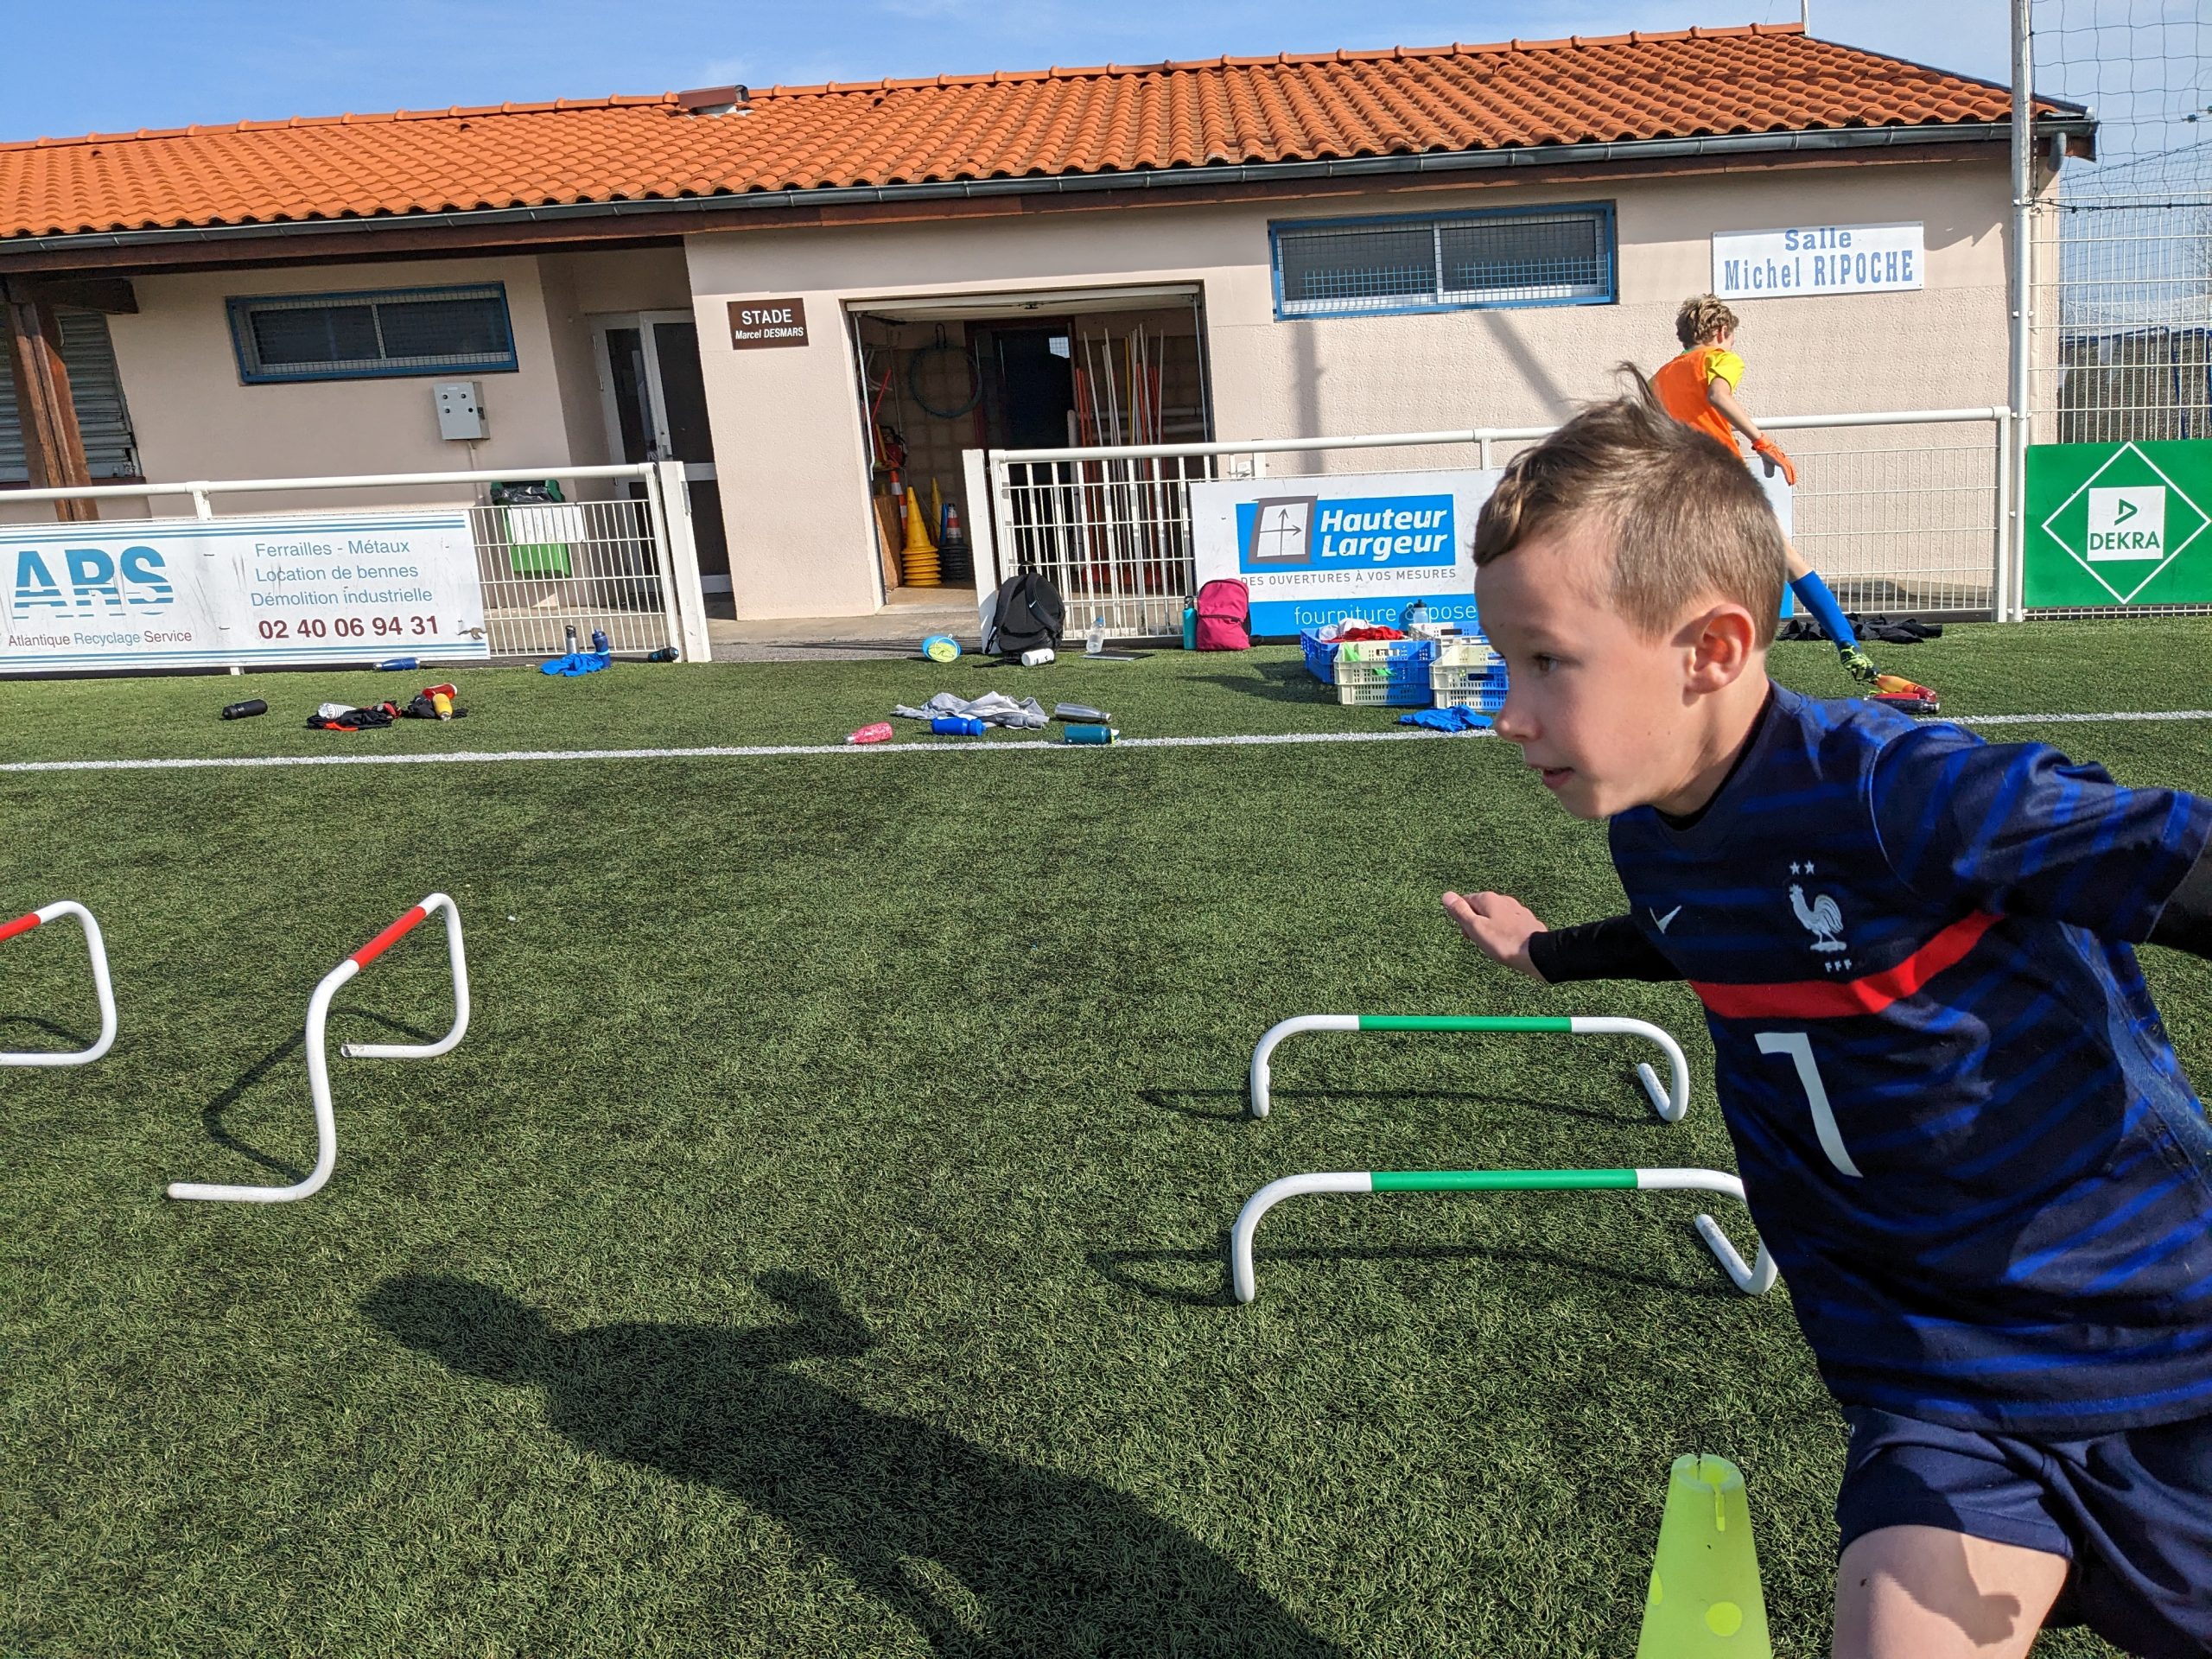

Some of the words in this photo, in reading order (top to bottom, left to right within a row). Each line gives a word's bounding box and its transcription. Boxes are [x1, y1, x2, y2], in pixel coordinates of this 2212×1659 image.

[1784, 227, 1852, 251] Salle
[1724, 257, 1801, 291] Michel
[1814, 250, 1913, 287] RIPOCHE
[741, 308, 793, 325] STADE
[735, 329, 762, 340] Marcel
[764, 327, 804, 338] DESMARS
[1319, 508, 1448, 533] Hauteur
[255, 542, 333, 557] Ferrailles
[347, 539, 410, 555] Métaux
[1322, 534, 1448, 562] Largeur
[2089, 531, 2161, 551] DEKRA
[12, 545, 175, 620] ARS
[255, 567, 327, 582] Location
[331, 565, 353, 580] de
[356, 564, 419, 579] bennes
[1241, 576, 1264, 587] DES
[1268, 573, 1351, 585] OUVERTURES
[1355, 569, 1363, 582] À
[1368, 570, 1391, 582] VOS
[1396, 569, 1457, 580] MESURES
[251, 590, 339, 607] Démolition
[343, 588, 434, 604] industrielle
[1428, 604, 1477, 623] pose
[258, 620, 289, 639] 02
[296, 619, 327, 639] 40
[334, 617, 365, 638] 06
[372, 616, 404, 637] 94
[410, 614, 439, 635] 31
[8, 633, 71, 649] Atlantique
[74, 632, 141, 646] Recyclage
[143, 630, 193, 644] Service
[1824, 958, 1853, 973] FFF
[1754, 1032, 1864, 1179] 7
